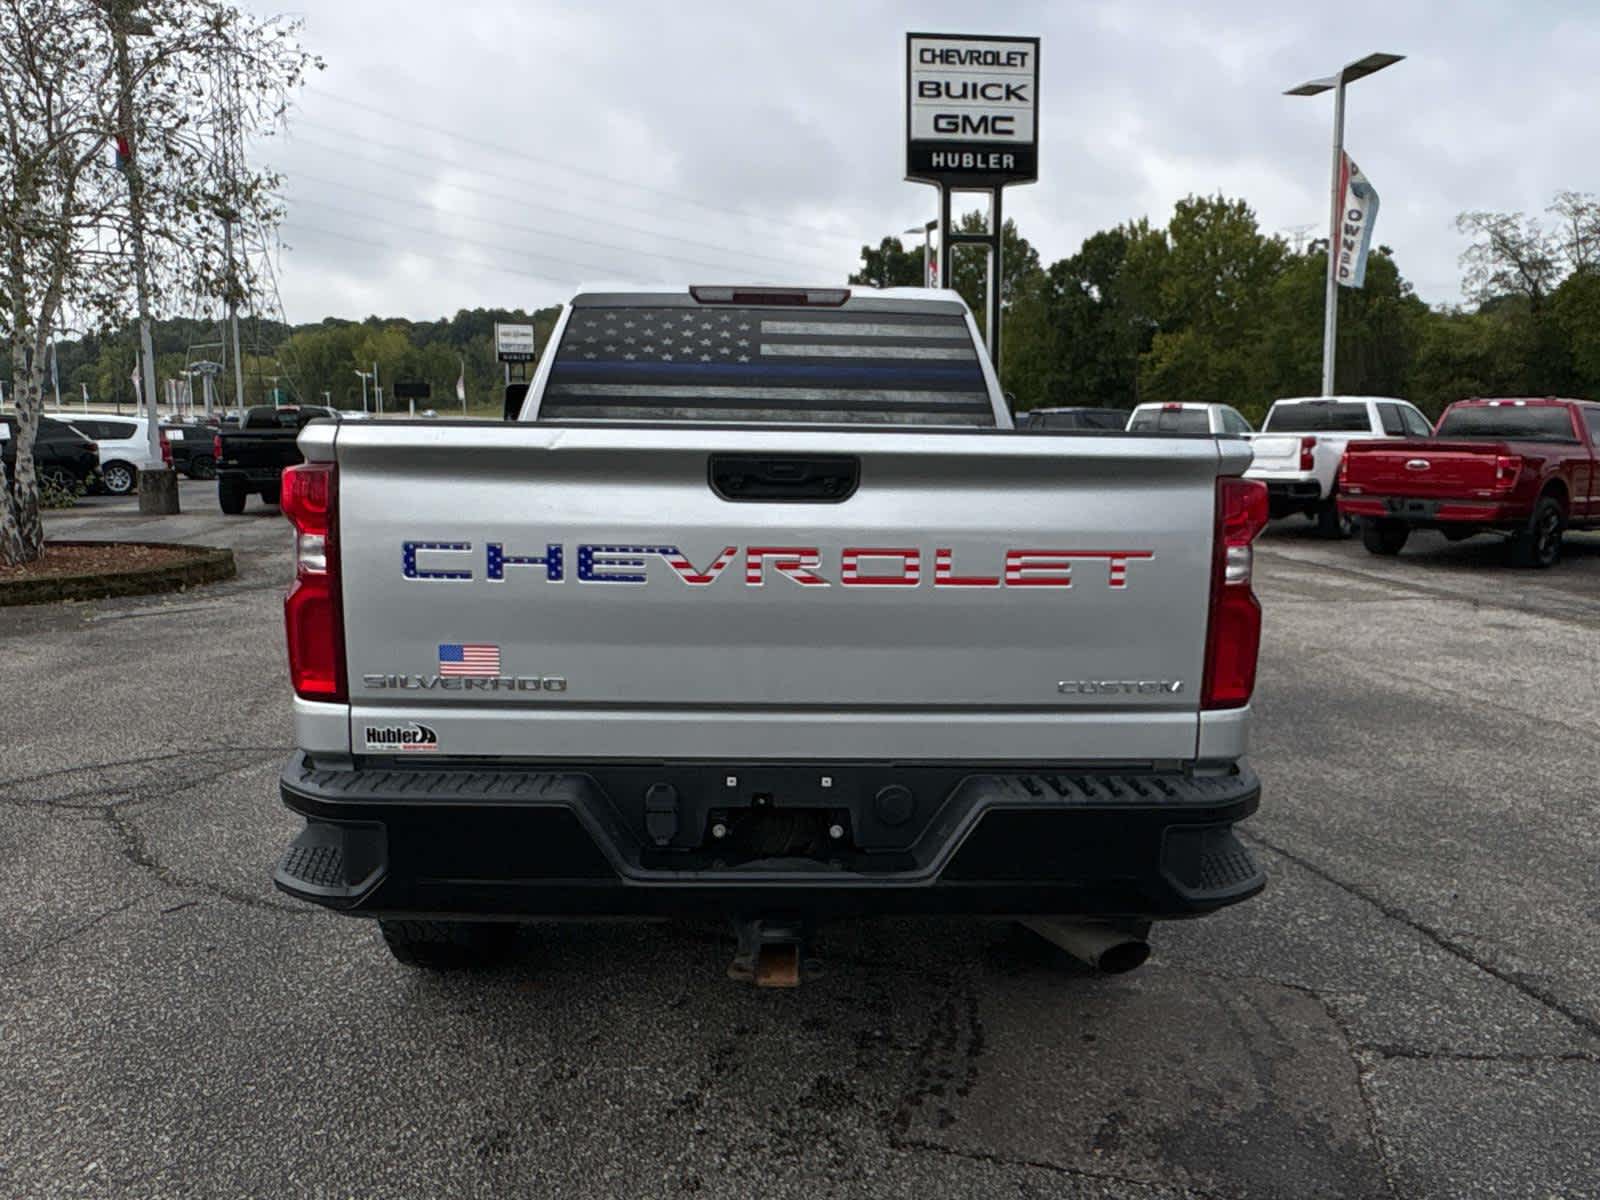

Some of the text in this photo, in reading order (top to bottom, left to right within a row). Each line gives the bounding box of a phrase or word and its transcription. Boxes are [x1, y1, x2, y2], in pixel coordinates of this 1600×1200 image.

[919, 48, 1029, 68] CHEVROLET
[918, 80, 1030, 102] BUICK
[933, 114, 1015, 135] GMC
[931, 152, 1015, 169] HUBLER
[402, 541, 1155, 590] CHEVROLET
[363, 674, 568, 692] SILVERADO
[1057, 680, 1183, 695] CUSTOM
[366, 727, 419, 744] Hubler
